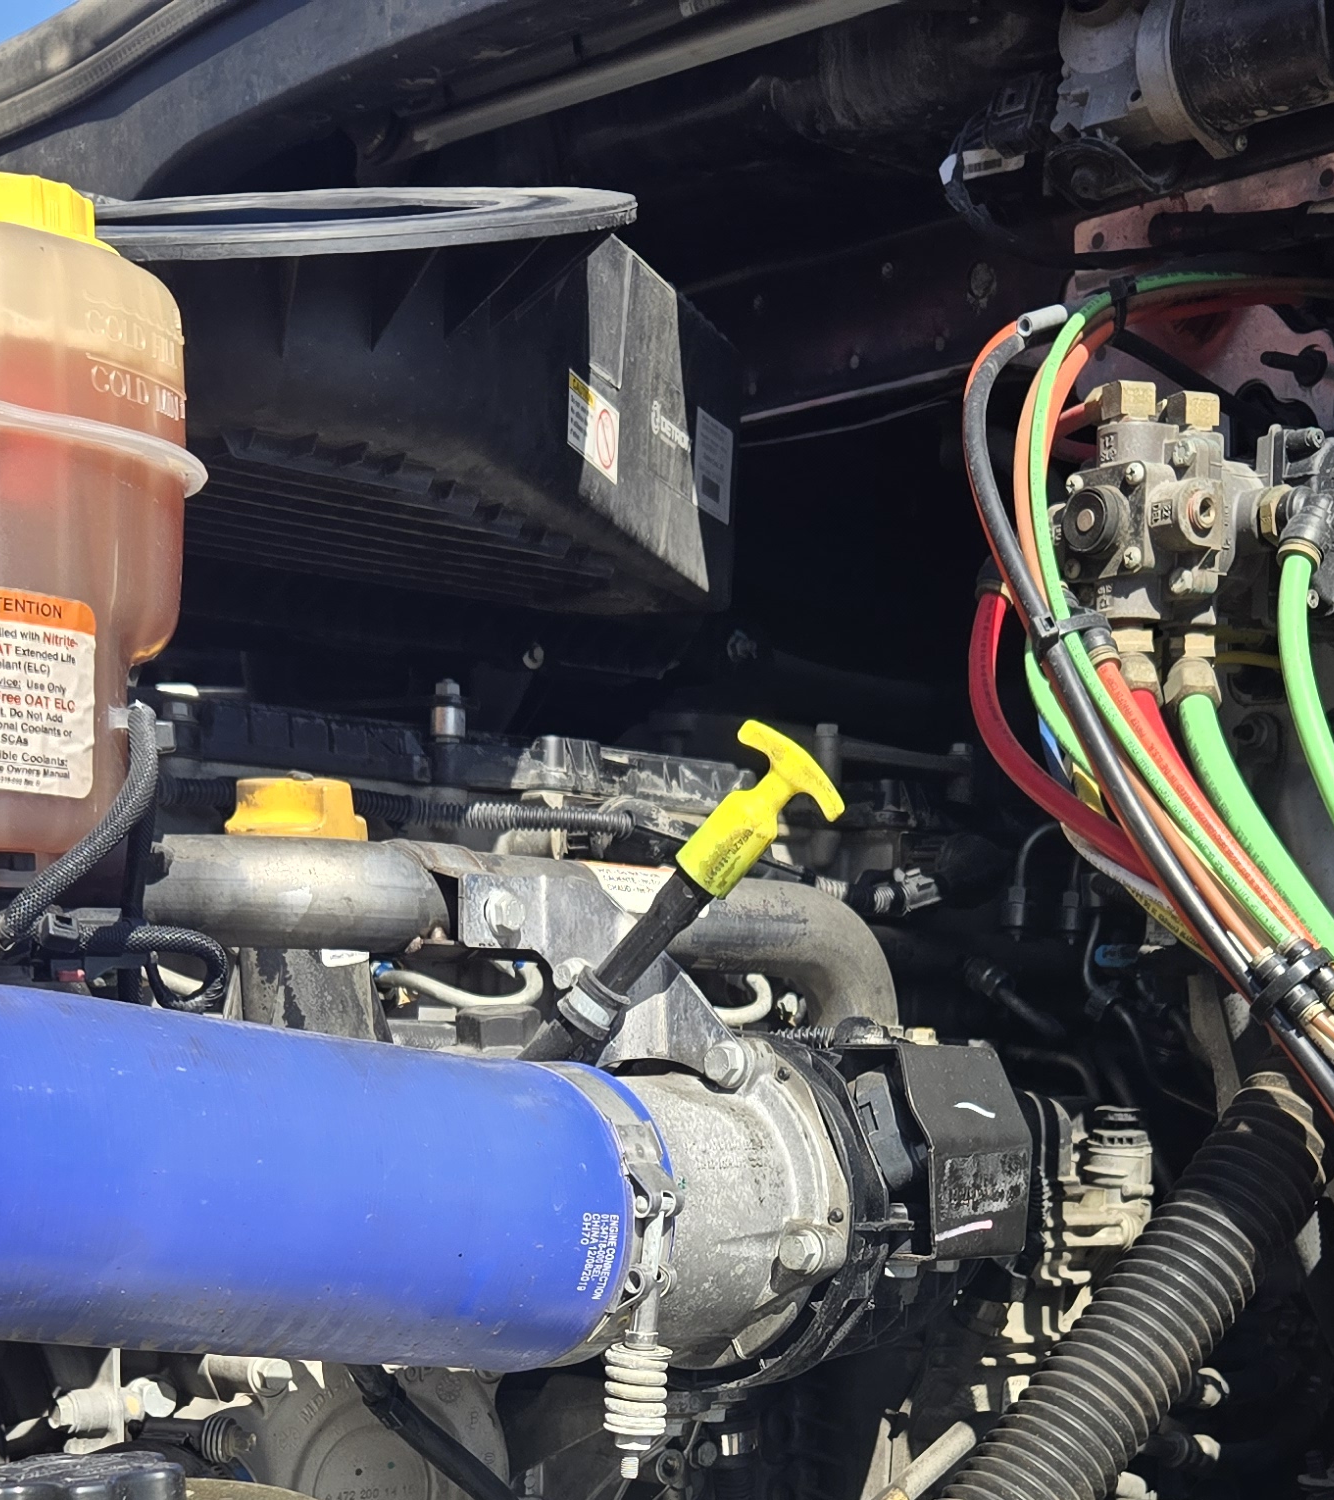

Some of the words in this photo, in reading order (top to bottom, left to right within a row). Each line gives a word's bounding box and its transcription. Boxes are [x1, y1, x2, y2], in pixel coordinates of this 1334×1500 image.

[85, 309, 147, 351] COLD
[91, 365, 149, 405] COLD
[20, 630, 40, 642] with
[43, 632, 78, 648] Nitrite-
[15, 645, 59, 662] Extended
[61, 653, 76, 664] Life
[23, 662, 50, 677] (ELC)
[26, 680, 45, 691] Use
[48, 683, 67, 696] Only
[24, 695, 50, 708] OAT
[54, 699, 76, 714] ELC
[10, 708, 24, 719] Do
[26, 710, 43, 722] Not
[46, 712, 63, 724] Add
[21, 722, 62, 737] Coolants
[63, 729, 72, 738] or
[0, 734, 29, 747] SCAs
[21, 753, 68, 767] Coolants:
[6, 764, 41, 778] Owners
[43, 767, 70, 780] Manual
[580, 1213, 592, 1245] GH70
[589, 1214, 601, 1244] CHINA
[607, 1214, 619, 1247] ENGINE
[592, 1248, 616, 1300] CONNECTION
[360, 1488, 379, 1500] 200
